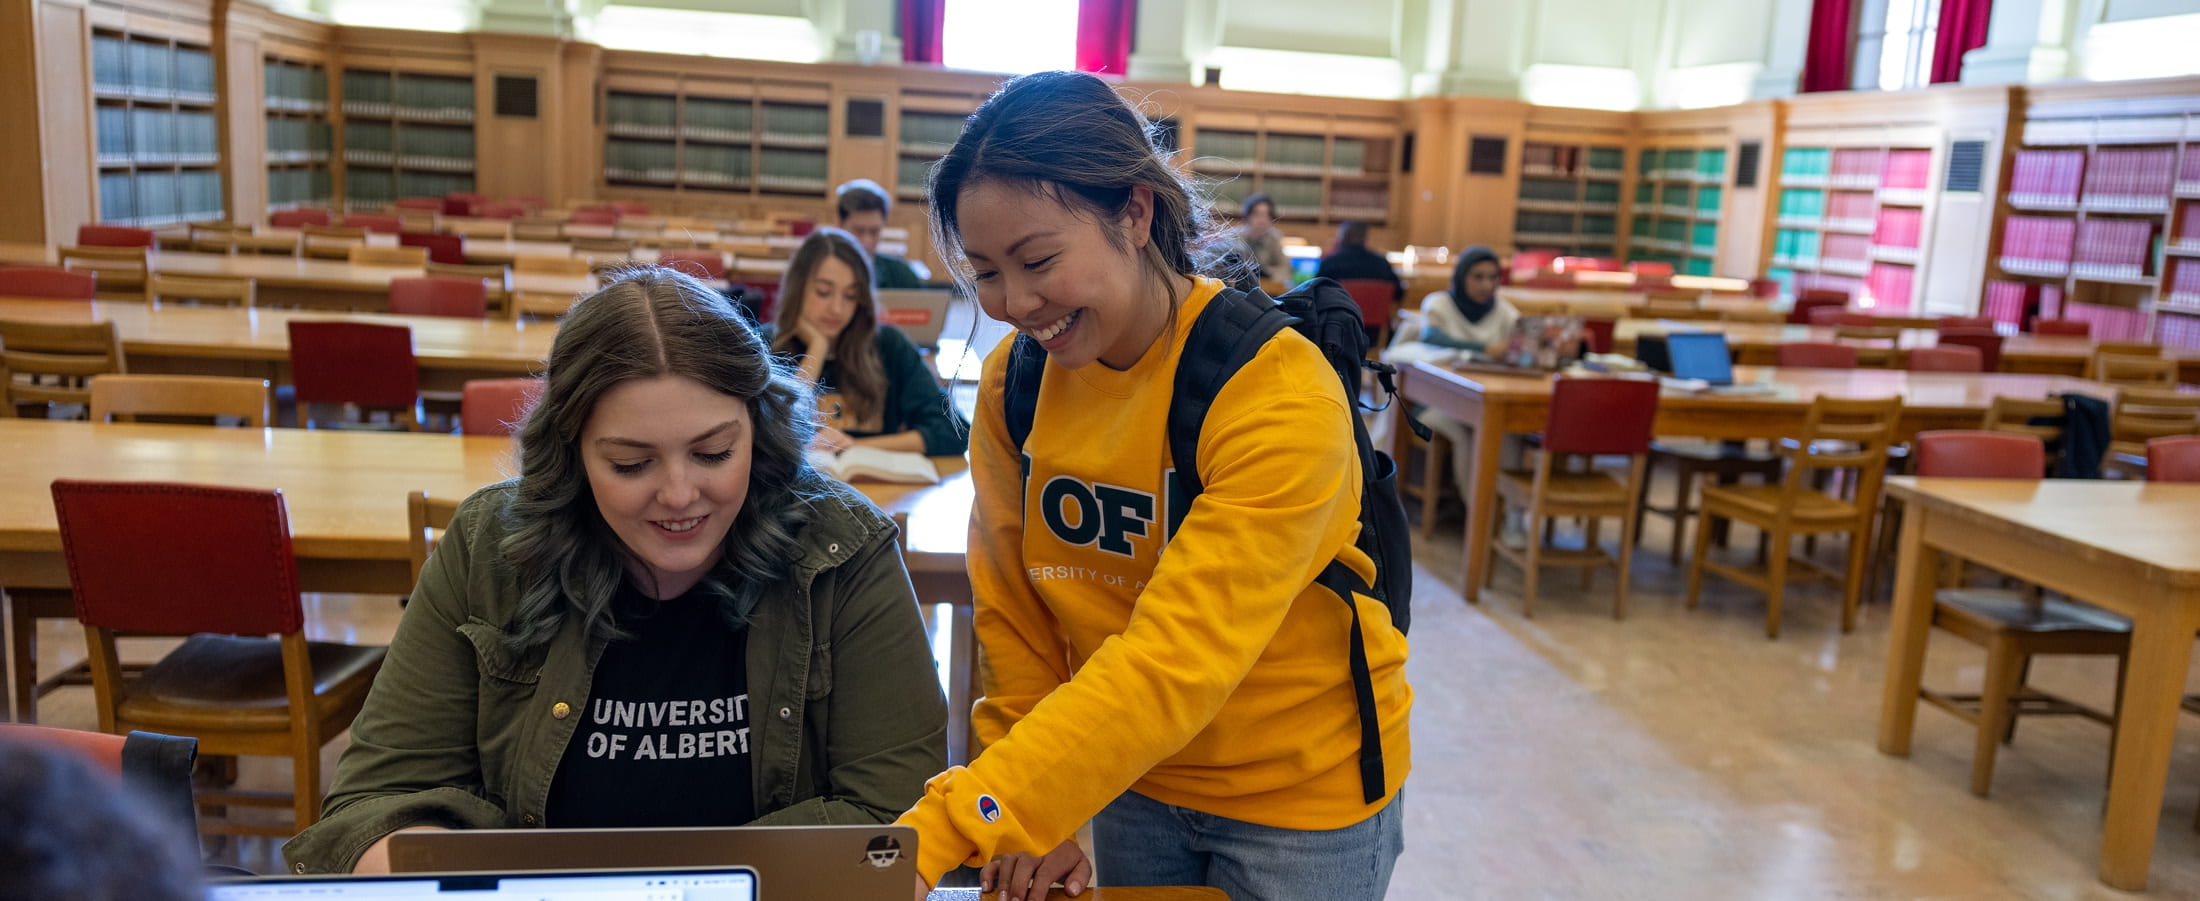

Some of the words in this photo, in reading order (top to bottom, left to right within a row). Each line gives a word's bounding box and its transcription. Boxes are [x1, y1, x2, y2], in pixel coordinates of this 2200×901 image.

[1040, 475, 1156, 560] OF
[1028, 565, 1097, 582] ERSITY
[1103, 574, 1127, 587] OF
[593, 694, 749, 728] UNIVERSIT
[587, 731, 627, 760] OF
[633, 727, 750, 761] ALBERT
